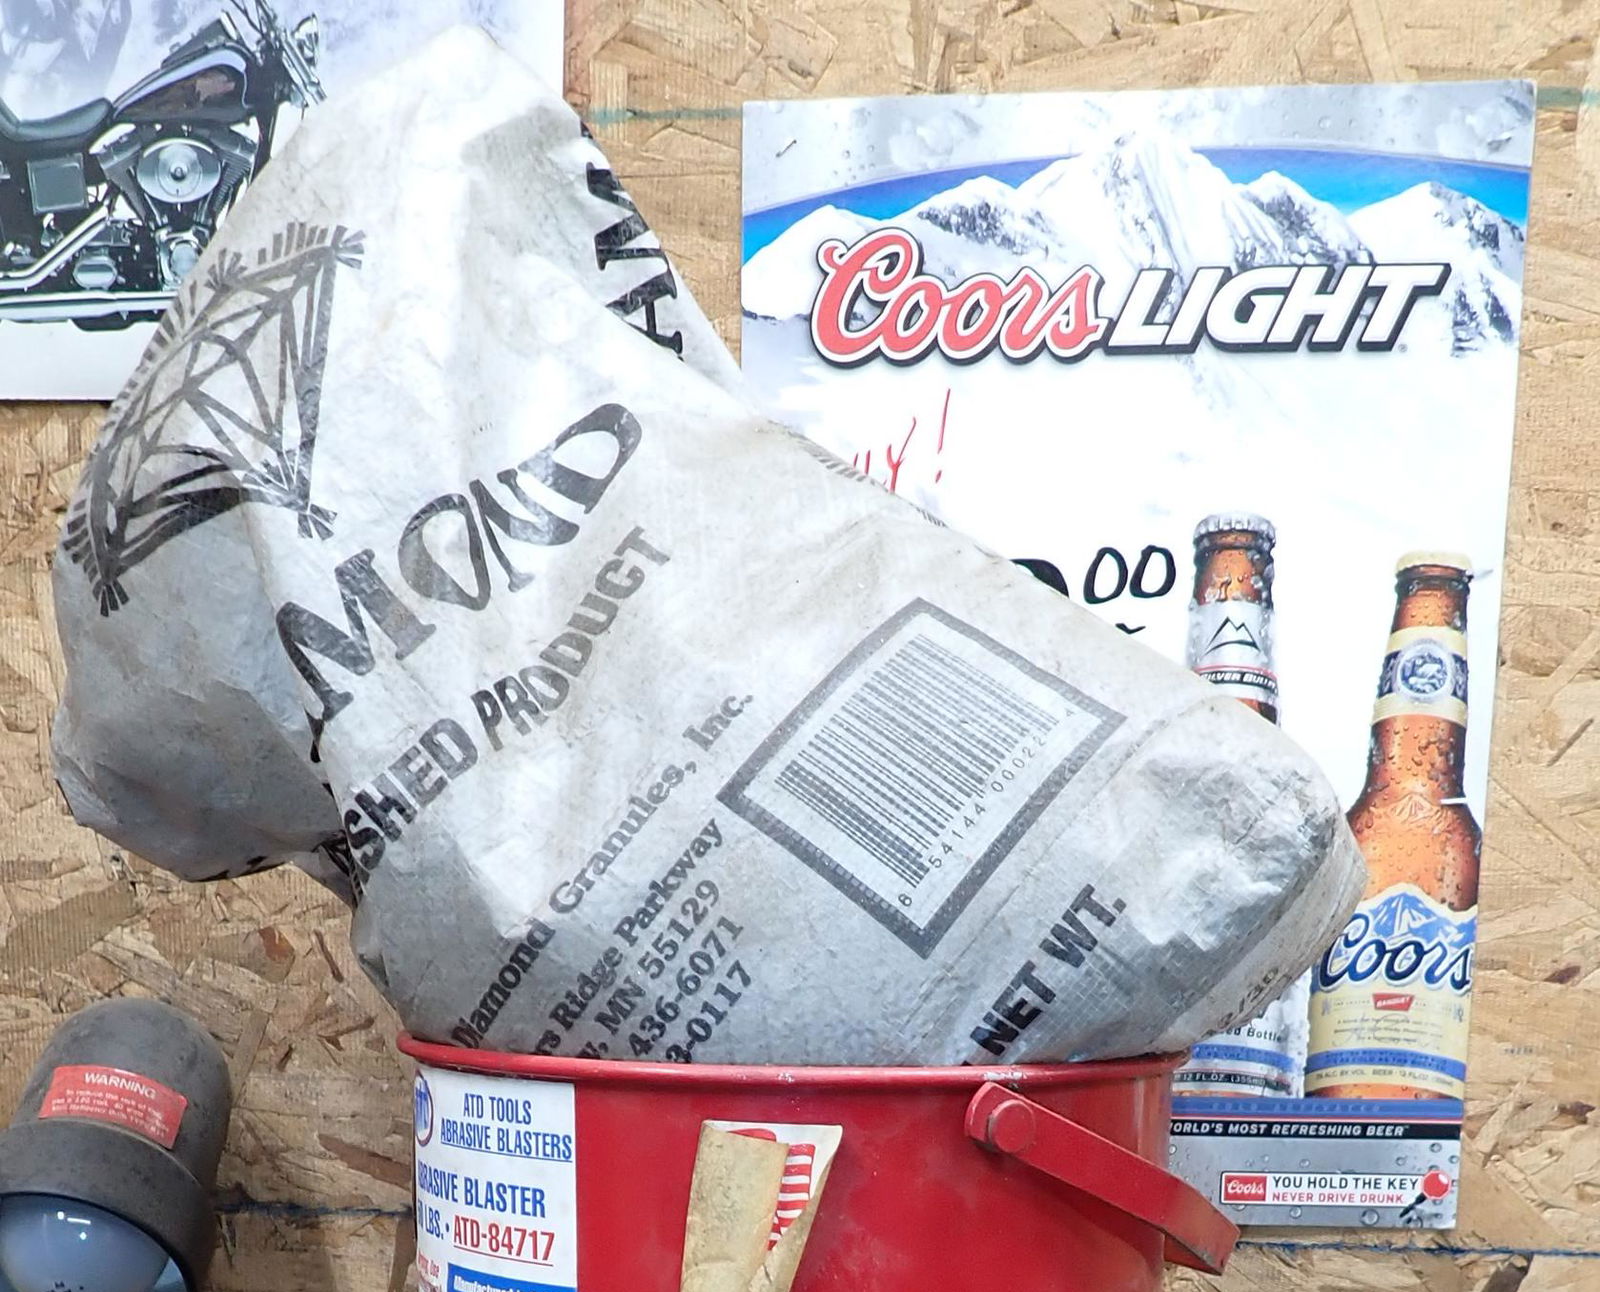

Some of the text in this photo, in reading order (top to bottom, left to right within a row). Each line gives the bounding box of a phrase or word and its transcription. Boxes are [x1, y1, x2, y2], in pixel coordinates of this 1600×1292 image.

[810, 227, 1451, 367] Coors LIGHT
[275, 402, 643, 764] MOND
[344, 525, 671, 870] SHED PRODUCT
[548, 759, 698, 915] Granules,
[682, 694, 753, 752] Inc.
[548, 817, 724, 1031] Ridge Parkway
[593, 975, 647, 1036] MN
[637, 879, 720, 980] 55129
[1319, 913, 1473, 991] Coors
[627, 915, 744, 1057] 436-6071
[969, 883, 1127, 1056] NET WT.
[664, 960, 752, 1064] 3-0117
[84, 1072, 157, 1101] WARNING
[463, 1092, 484, 1120] ATD
[488, 1096, 532, 1126] TOOLS
[440, 1117, 573, 1161] ABRASIVE BLASTERS
[1169, 1121, 1405, 1138] ORLD'S MOST REFRESHING BEER
[464, 1175, 547, 1219] BLASTER
[1225, 1179, 1266, 1196] Coors
[1271, 1191, 1404, 1205] NEVER DRIVE DRUNK
[1272, 1175, 1420, 1191] YOU HOLD THE KEY
[424, 1203, 445, 1241] LBS.
[453, 1214, 556, 1262] ATD-84717
